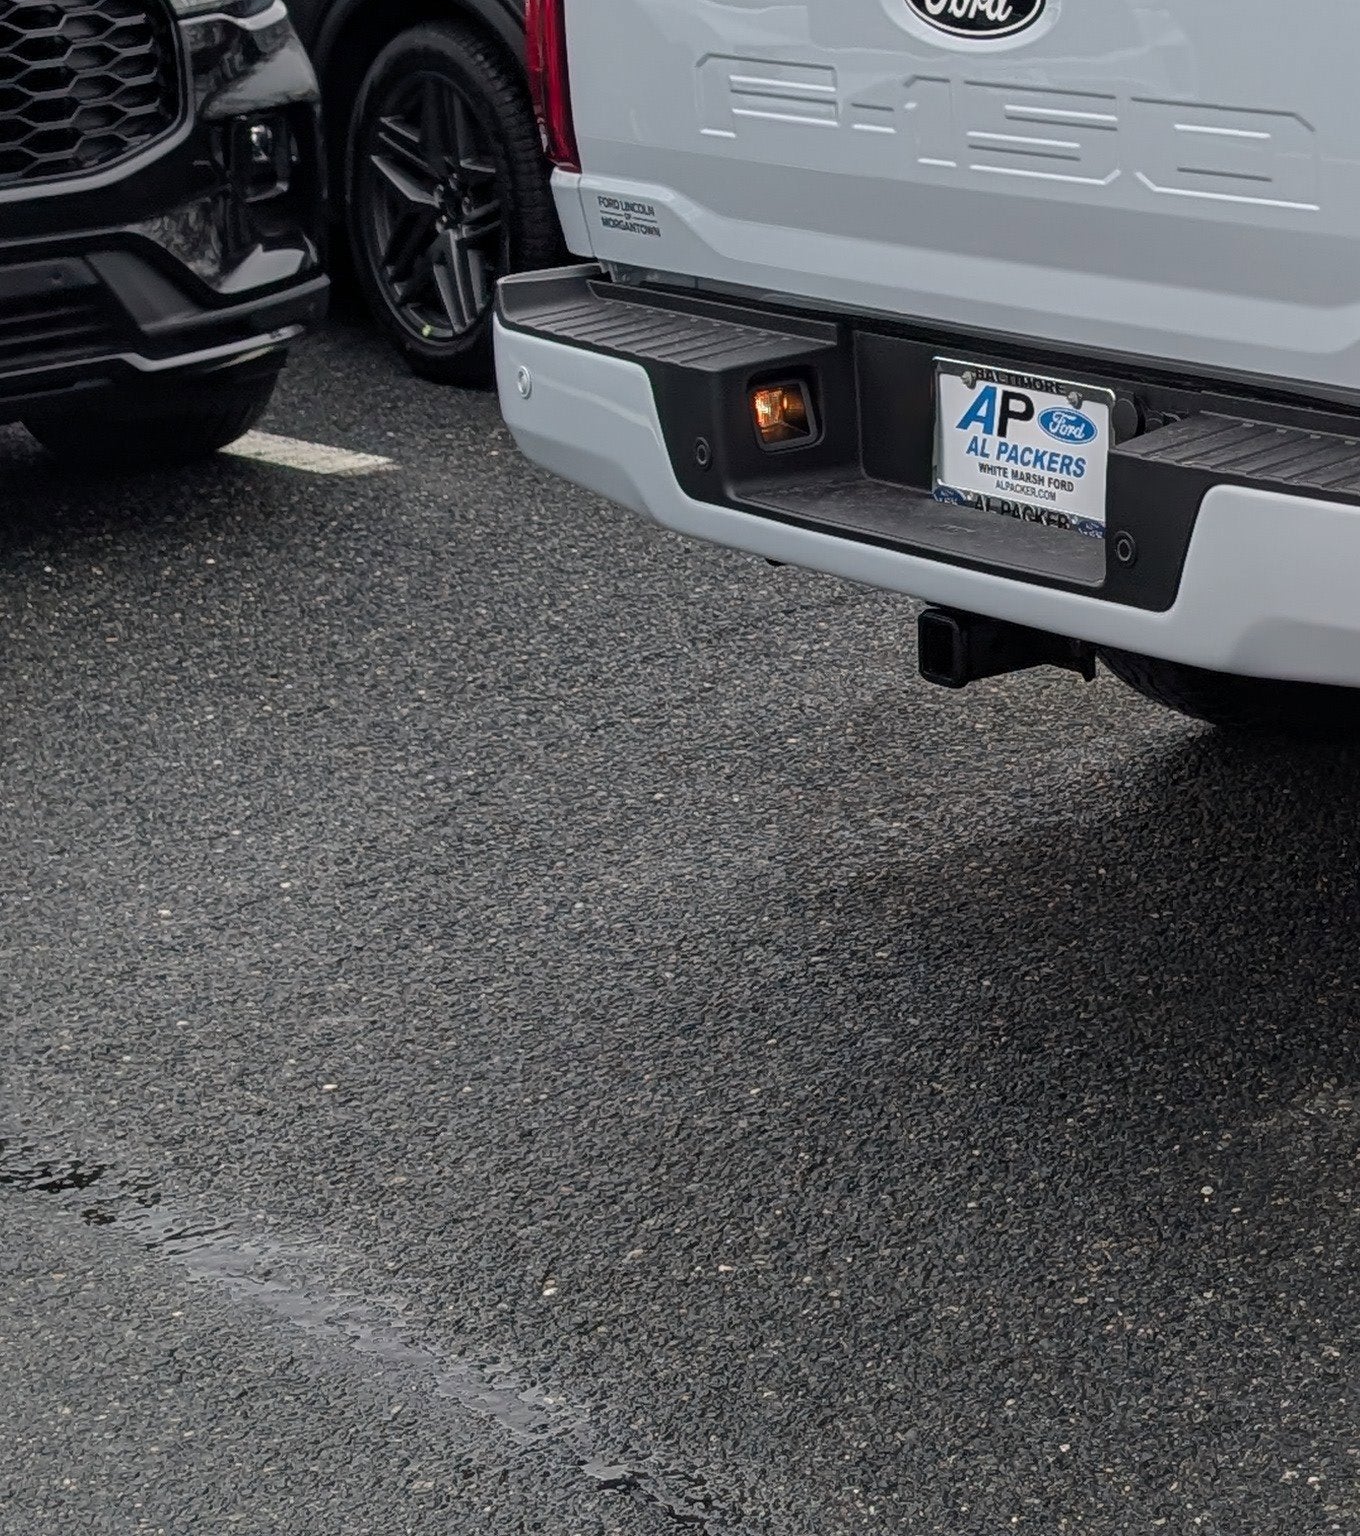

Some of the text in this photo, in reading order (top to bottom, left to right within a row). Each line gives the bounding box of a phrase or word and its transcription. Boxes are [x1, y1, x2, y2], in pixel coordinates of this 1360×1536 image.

[695, 52, 1320, 211] F-150
[974, 368, 1066, 395] BALTIMORE
[956, 385, 1035, 438] AP
[966, 436, 1087, 478] AL PACKERS
[978, 462, 1075, 492] WHITE MARSH FORD
[995, 479, 1057, 502] ALPACKER.COM
